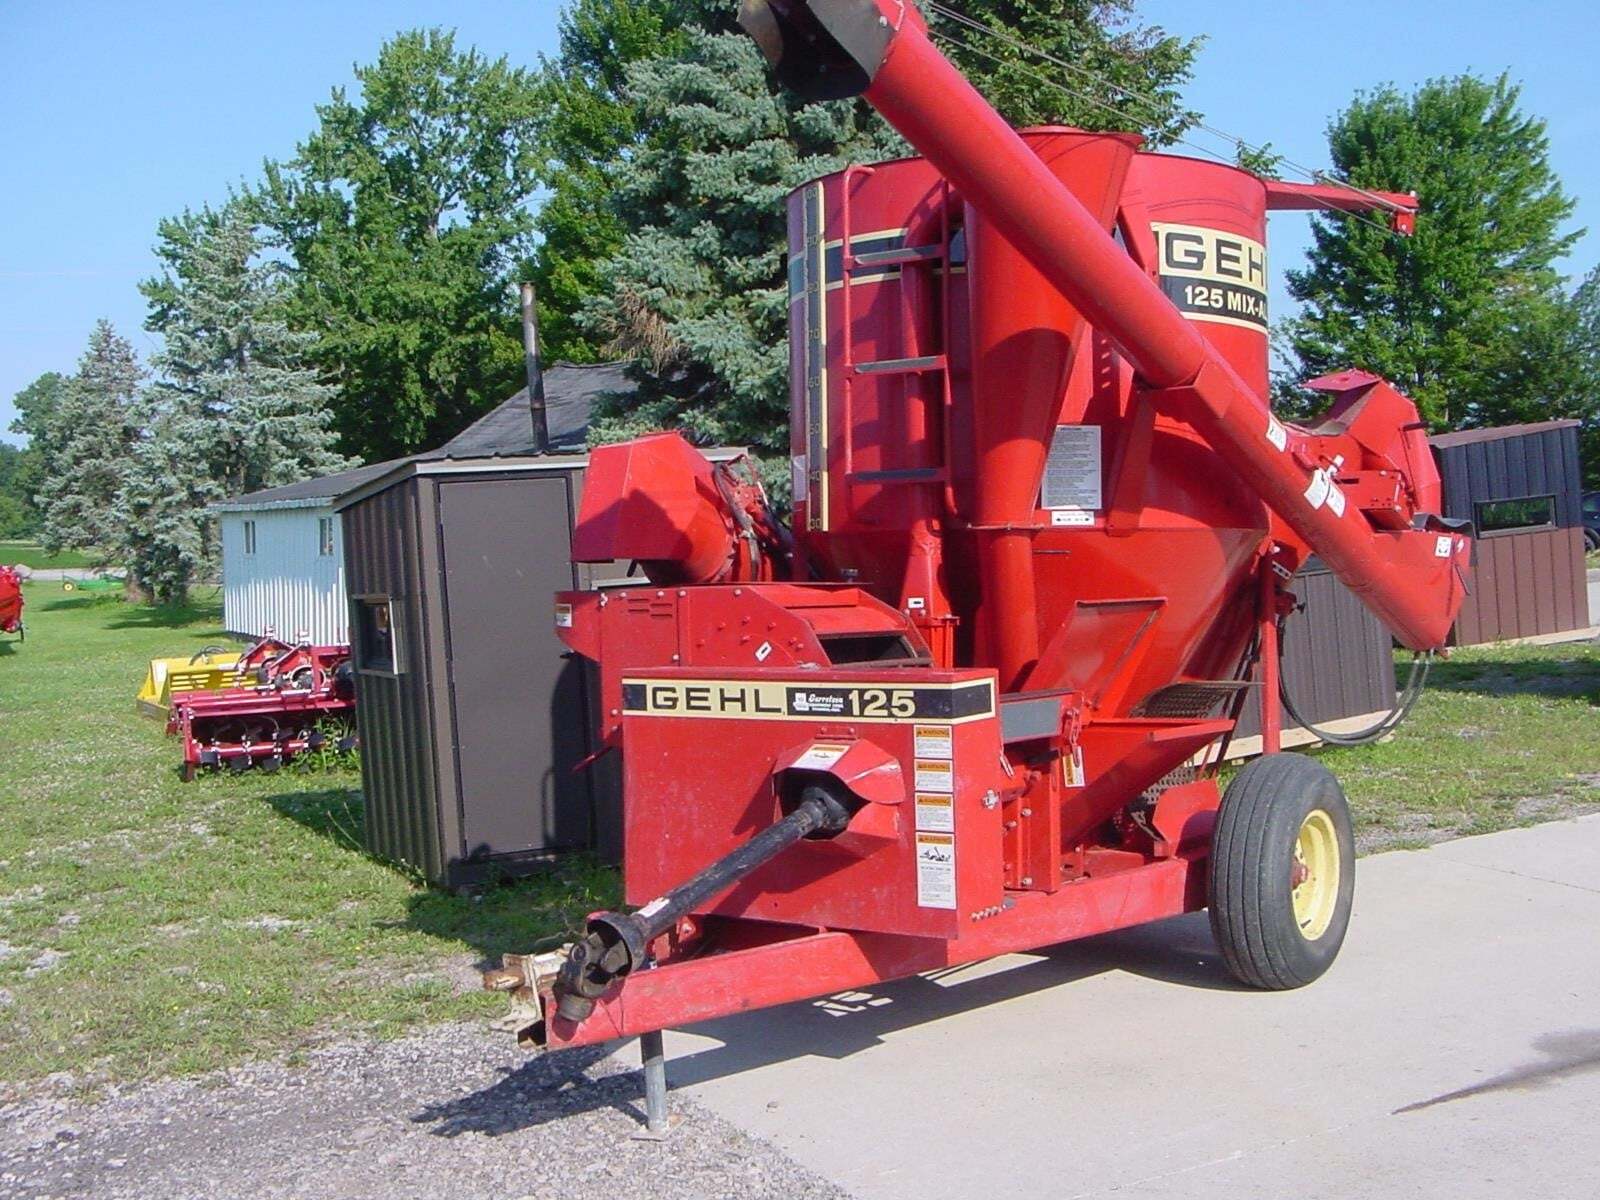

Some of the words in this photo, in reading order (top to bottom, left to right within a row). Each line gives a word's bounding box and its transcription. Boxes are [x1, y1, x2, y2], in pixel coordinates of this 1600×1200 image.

[1184, 285, 1224, 309] 125
[651, 687, 782, 713] GEHL
[849, 691, 915, 717] 125
